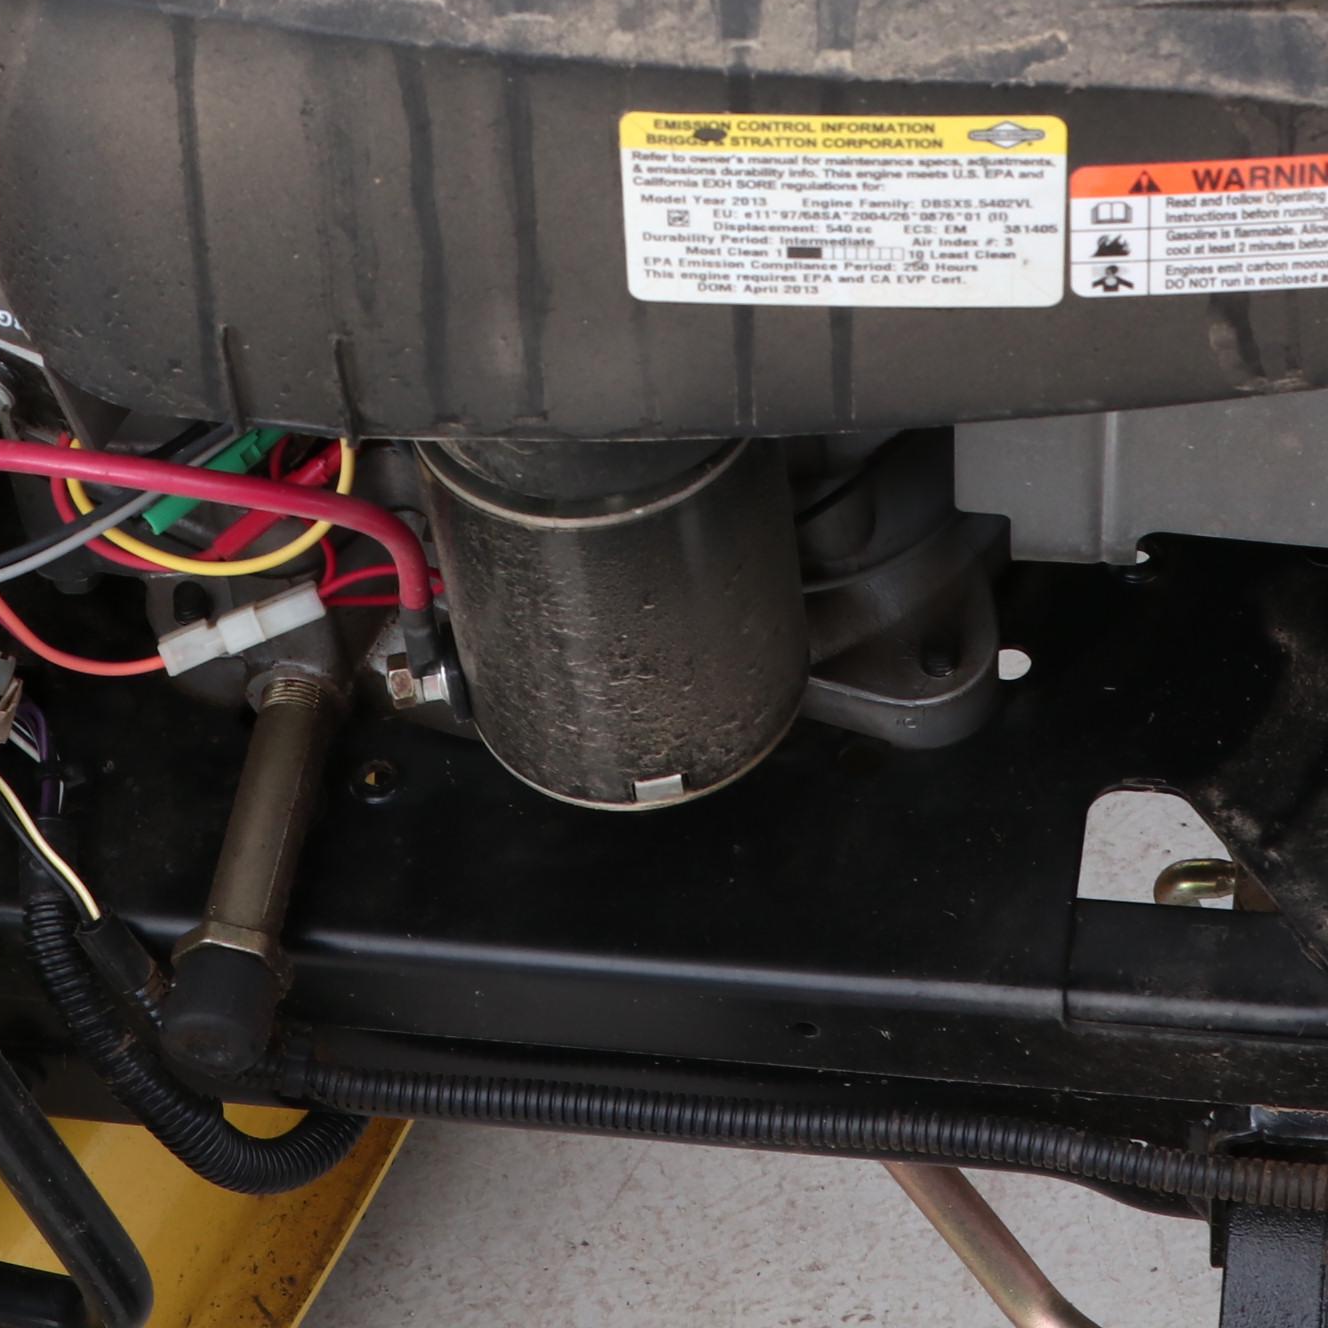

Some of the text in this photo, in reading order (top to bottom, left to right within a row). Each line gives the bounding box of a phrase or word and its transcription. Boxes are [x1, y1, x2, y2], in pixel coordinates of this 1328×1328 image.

[654, 119, 935, 134] EMISSION CONTROL INFORMATION
[731, 136, 818, 148] STRATTON
[822, 138, 944, 149] CORPORATION
[632, 151, 668, 162] Refer
[672, 153, 685, 163] to
[690, 154, 743, 165] owner's
[748, 155, 798, 166] manual
[802, 155, 821, 166] for
[826, 156, 914, 166] maintenance
[647, 165, 716, 175] emissions
[722, 167, 784, 179] durability
[788, 168, 818, 178] info.
[825, 168, 852, 179] This
[856, 170, 902, 181] engine
[907, 170, 948, 180] meets
[953, 170, 980, 180] U.S.
[985, 170, 1014, 180] EPA
[1018, 169, 1044, 179] and
[633, 177, 886, 192] California EXH SORE regulations for:
[1166, 190, 1326, 208] Read and follow Operating
[1166, 209, 1238, 224] Instructions
[1242, 208, 1280, 220] before
[1166, 228, 1218, 242] Gasoline
[1234, 224, 1298, 239] flammable.
[1166, 244, 1192, 256] cool
[1208, 242, 1236, 254] least
[1248, 239, 1296, 252] minutes
[1166, 264, 1214, 278] Engines
[1217, 262, 1242, 274] emit
[1246, 260, 1288, 273] carbon
[1166, 277, 1186, 290] DO
[1189, 276, 1217, 288] NOT
[1221, 276, 1242, 287] run
[1258, 272, 1317, 286] enclosed
